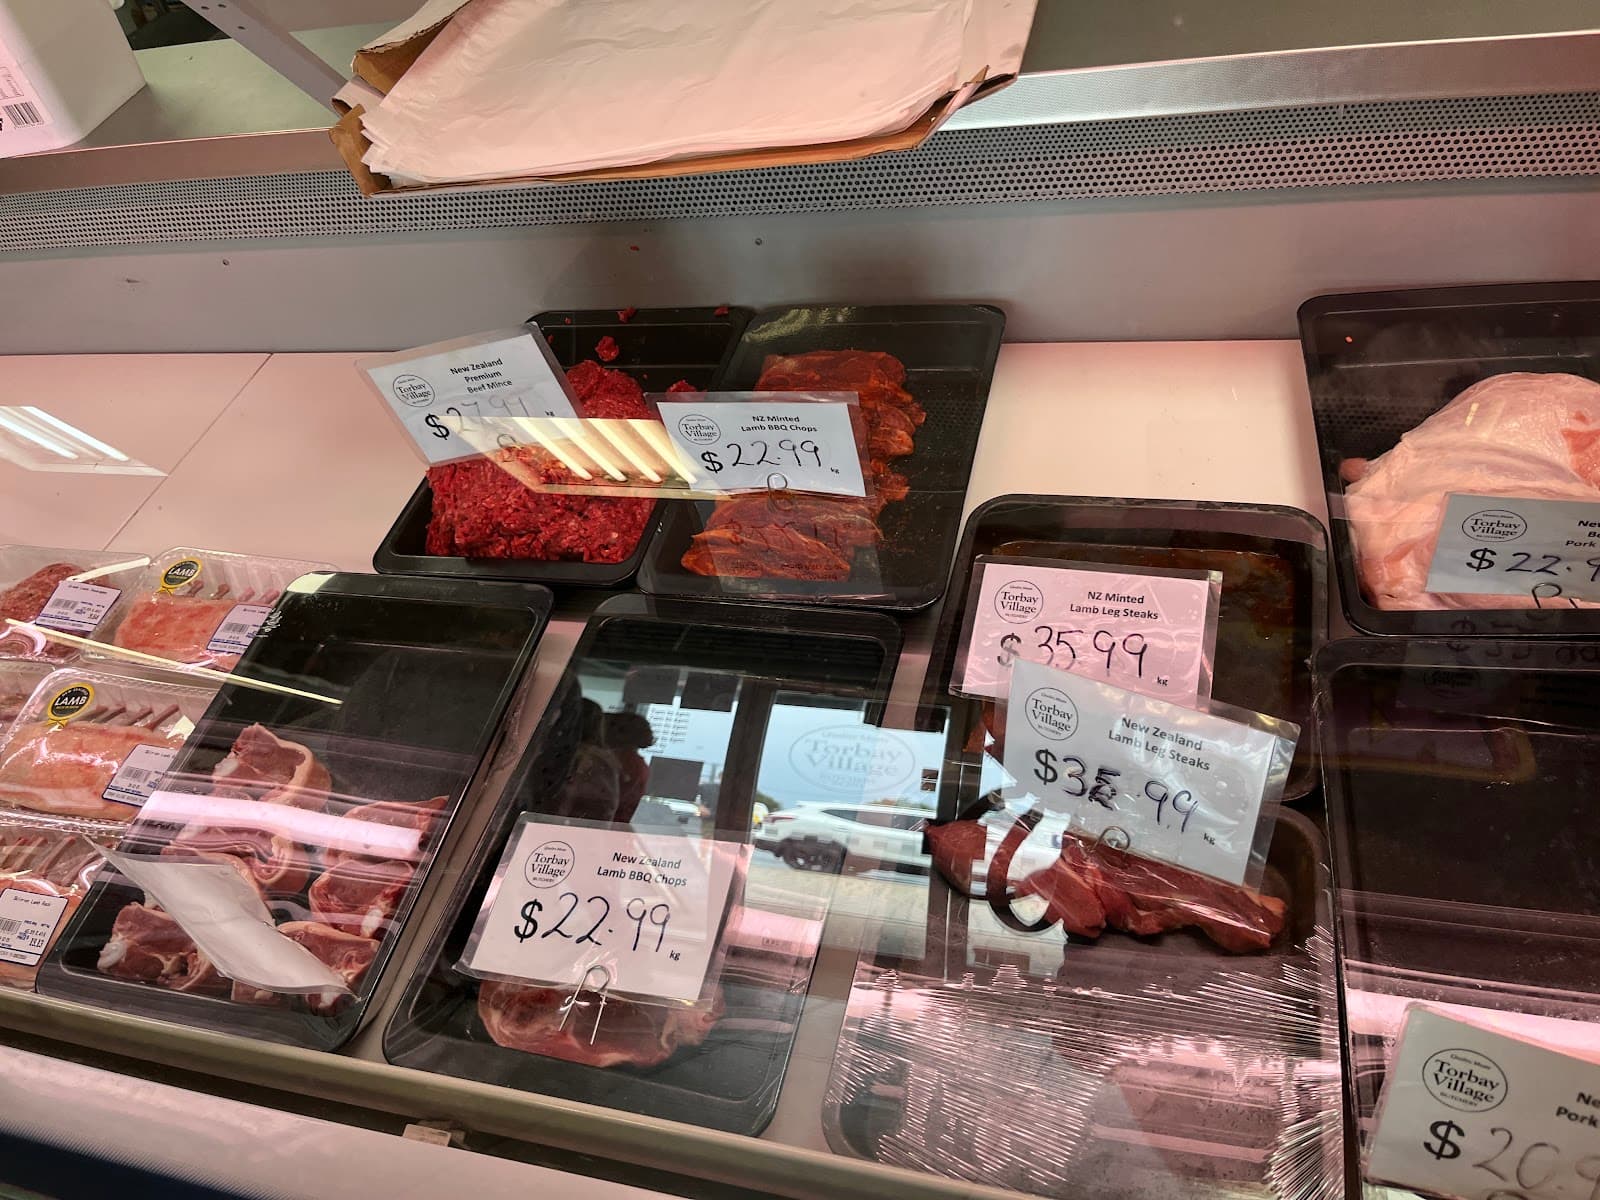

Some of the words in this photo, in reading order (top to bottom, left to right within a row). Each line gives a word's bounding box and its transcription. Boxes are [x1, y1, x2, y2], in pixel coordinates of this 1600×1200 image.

[450, 365, 470, 376] New
[471, 358, 504, 371] Zealand
[464, 370, 503, 383] Premium
[396, 382, 427, 394] Torbay
[467, 383, 487, 394] Beef
[487, 379, 513, 391] Mince
[402, 390, 432, 401] Village
[766, 415, 800, 423] Minted
[681, 422, 716, 432] Torbay
[685, 429, 719, 439] Village
[741, 424, 766, 432] Lamb
[767, 424, 788, 432] BBQ
[789, 424, 818, 433] Chops
[1470, 518, 1521, 529] Torbay
[1470, 525, 1518, 537] Village
[1565, 540, 1597, 549] Pork
[167, 567, 197, 577] LAMB
[1000, 590, 1039, 605] Torbay
[1087, 590, 1103, 601] NZ
[1104, 592, 1145, 604] Minted
[999, 601, 1037, 614] Village
[1070, 603, 1099, 615] Lamb
[1101, 605, 1121, 618] Leg
[1122, 606, 1159, 620] Steaks
[1156, 676, 1169, 687] kg
[54, 695, 89, 706] LAMB
[1032, 697, 1074, 722] Torbay
[1031, 708, 1071, 733] Village
[1121, 716, 1150, 734] New
[1152, 725, 1203, 752] Zealand
[1108, 729, 1143, 748] Lamb
[1145, 740, 1166, 758] Leg
[1168, 748, 1211, 772] Steaks
[533, 851, 571, 868] Torbay
[612, 851, 638, 865] New
[639, 854, 682, 870] Zealand
[531, 862, 567, 879] Village
[597, 866, 627, 880] Lamb
[628, 869, 653, 884] BBQ
[654, 872, 688, 888] Chops
[513, 891, 671, 953] $22.99
[669, 949, 682, 962] kg
[1434, 1058, 1500, 1091] Torbay
[1432, 1072, 1496, 1103] Village
[1555, 1105, 1599, 1129] Pork
